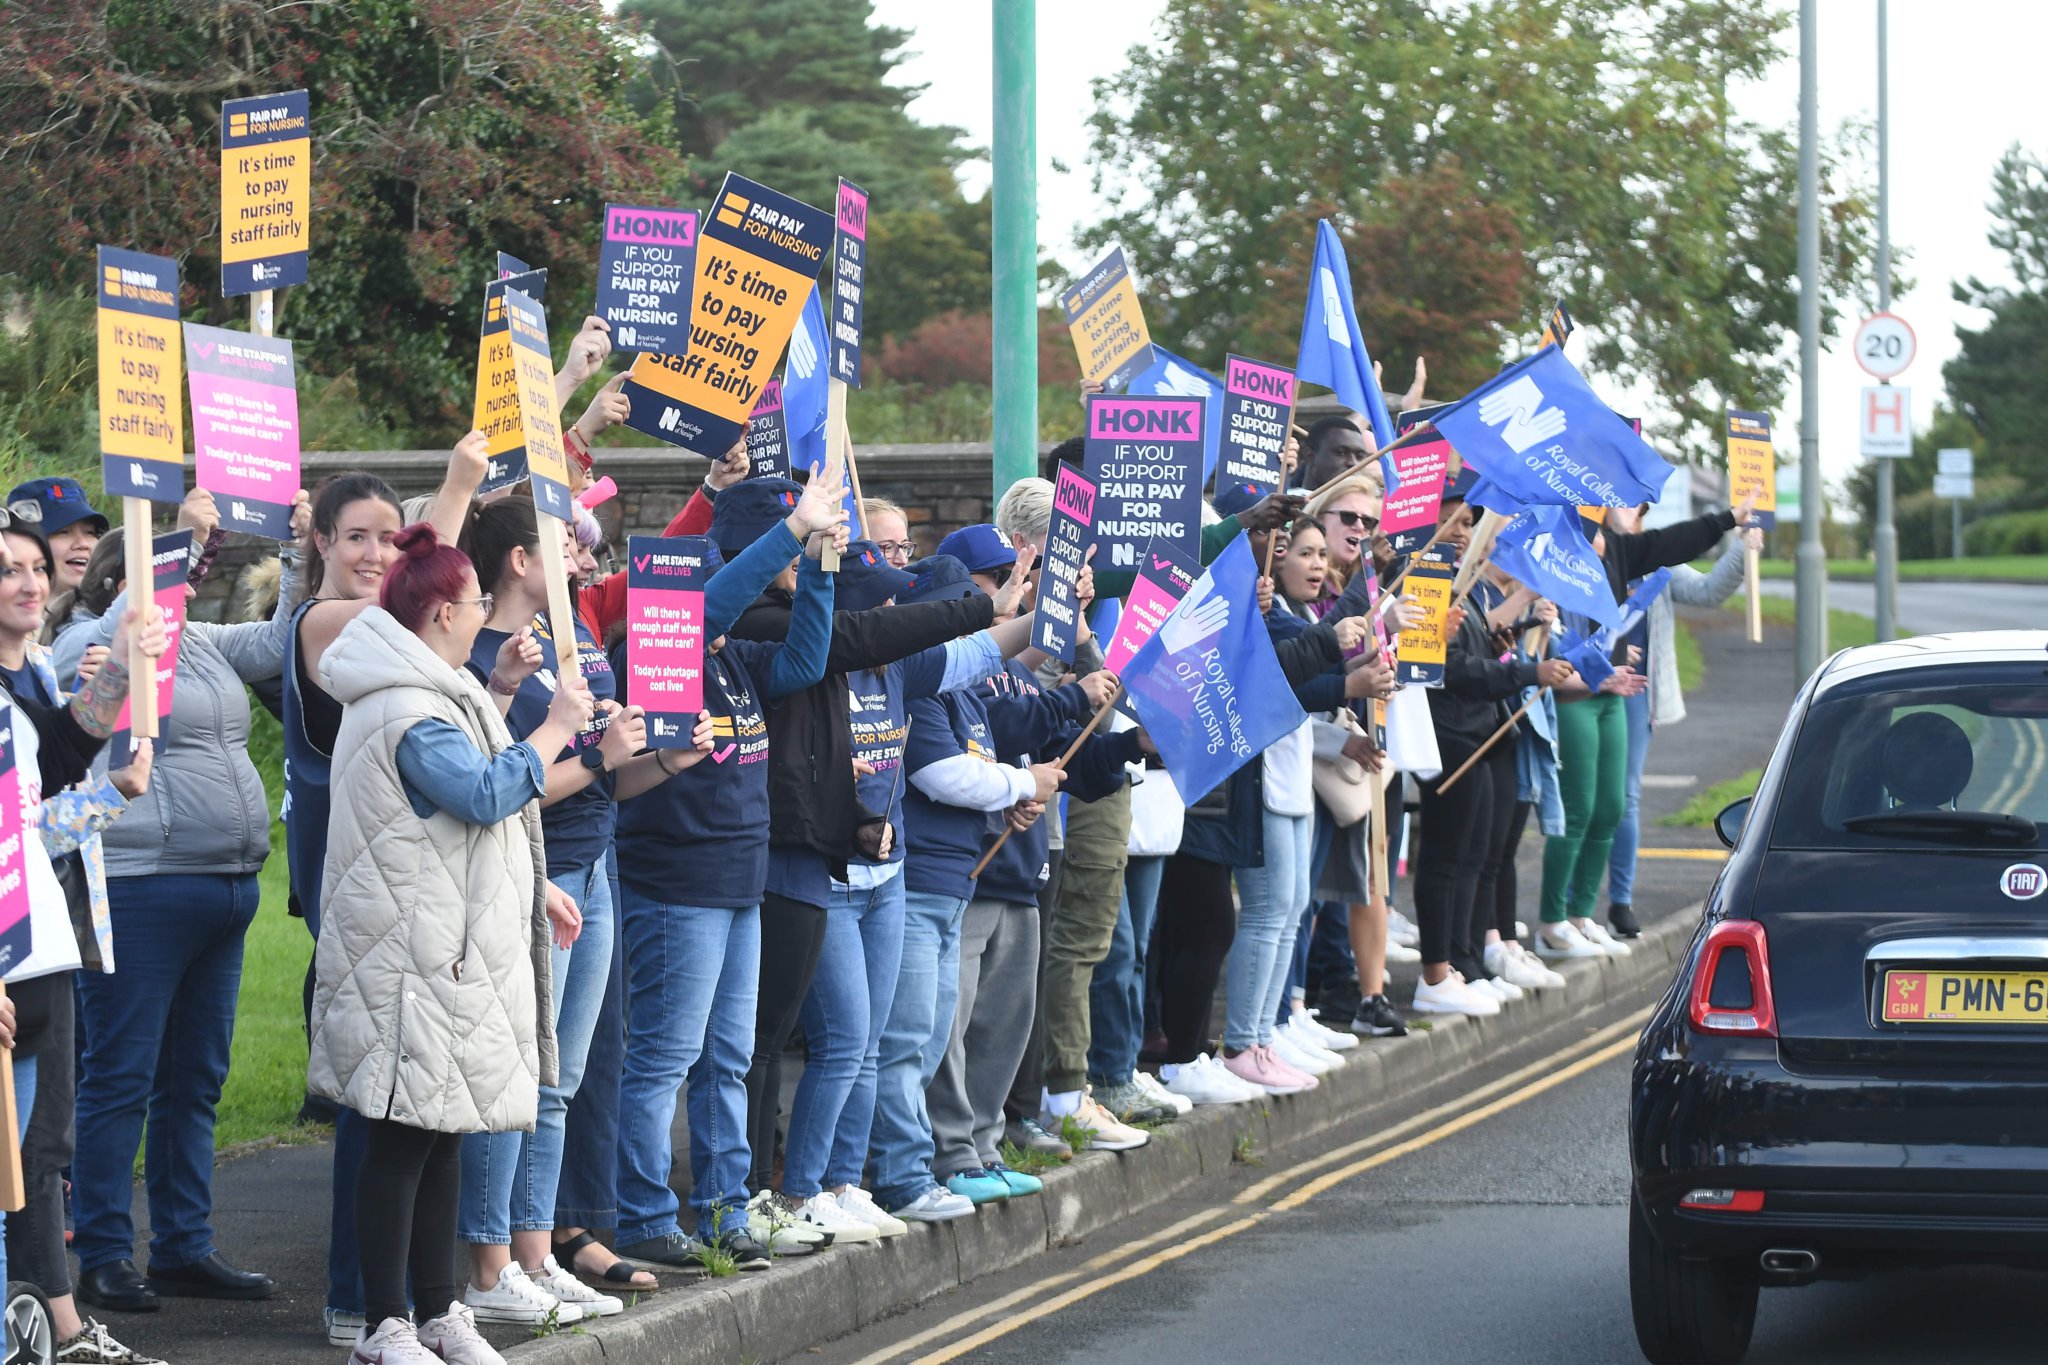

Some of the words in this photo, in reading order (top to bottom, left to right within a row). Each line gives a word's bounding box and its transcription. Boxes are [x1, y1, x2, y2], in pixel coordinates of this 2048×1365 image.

[250, 110, 270, 122] FAIR
[271, 107, 288, 119] PAY
[250, 121, 267, 134] FOR
[268, 116, 304, 131] NURSING
[239, 157, 260, 173] It's
[264, 153, 295, 170] time
[246, 181, 260, 195] to
[264, 178, 288, 197] pay
[240, 198, 293, 219] nursing
[840, 194, 864, 232] HONK
[613, 215, 689, 240] HONK
[749, 202, 778, 227] FAIR
[777, 213, 805, 236] PAY
[231, 224, 264, 244] staff
[267, 219, 301, 239] fairly
[743, 219, 769, 241] FOR
[770, 229, 822, 261] NURSING
[625, 245, 638, 259] IF
[641, 246, 672, 262] YOU
[849, 242, 860, 261] YOU
[612, 260, 682, 279] SUPPORT
[839, 257, 861, 283] SUPPORT
[612, 276, 647, 292] FAIR
[650, 279, 680, 294] PAY
[704, 256, 738, 287] It's
[740, 271, 788, 306] time
[628, 293, 660, 308] FOR
[1099, 292, 1123, 317] time
[607, 307, 678, 325] NURSING
[701, 291, 724, 316] to
[724, 304, 766, 337] pay
[843, 302, 855, 323] FOR
[835, 320, 859, 347] NURSING
[1091, 328, 1102, 341] to
[1103, 310, 1122, 333] pay
[137, 328, 165, 352] time
[1091, 321, 1131, 359] nursing
[1866, 334, 1902, 359] 20
[1089, 351, 1113, 377] staff
[1113, 329, 1140, 356] fairly
[121, 356, 134, 375] to
[138, 362, 159, 384] pay
[491, 371, 502, 386] to
[706, 362, 759, 405] fairly
[1233, 367, 1289, 399] HONK
[117, 387, 165, 414] nursing
[1240, 399, 1252, 413] IF
[1252, 402, 1277, 420] YOU
[1098, 408, 1193, 433] HONK
[1868, 391, 1902, 433] H
[109, 415, 139, 434] staff
[143, 416, 174, 444] fairly
[530, 415, 556, 441] nursing
[757, 416, 774, 429] YOU
[1231, 414, 1284, 437] SUPPORT
[746, 428, 780, 446] SUPPORT
[1230, 429, 1258, 448] FAIR
[1258, 435, 1282, 453] PAY
[530, 440, 547, 458] staff
[766, 443, 782, 457] PAY
[1114, 445, 1130, 460] IF
[1134, 445, 1174, 461] YOU
[1242, 448, 1267, 466] FOR
[758, 459, 775, 473] FOR
[1525, 456, 1551, 471] of
[1545, 444, 1589, 478] Royal
[1099, 463, 1187, 481] SUPPORT
[1226, 461, 1280, 485] NURSING
[1058, 477, 1092, 518] HONK
[1100, 483, 1145, 499] FAIR
[1148, 484, 1186, 500] PAY
[1122, 502, 1162, 518] FOR
[1058, 518, 1067, 535] IF
[1067, 523, 1081, 543] YOU
[1097, 520, 1186, 538] NURSING
[1051, 535, 1082, 565] SUPPORT
[652, 555, 670, 565] SAFE
[670, 555, 701, 567] STAFFING
[652, 565, 673, 575] SAVES
[674, 567, 691, 577] LIVES
[1048, 555, 1065, 579] FAIR
[1063, 564, 1079, 585] PAY
[1171, 565, 1193, 584] SAFE
[1052, 579, 1068, 601] FOR
[1424, 585, 1442, 598] time
[643, 606, 659, 618] Will
[660, 607, 681, 619] there
[681, 609, 691, 619] be
[1041, 595, 1074, 625] NURSING
[1149, 599, 1167, 618] Will
[632, 622, 661, 635] enough
[662, 623, 680, 634] staff
[681, 624, 701, 635] when
[638, 637, 653, 649] you
[654, 636, 673, 648] need
[675, 637, 694, 649] care?
[1401, 637, 1420, 649] staff
[1421, 638, 1440, 653] fairly
[634, 665, 662, 678] Today's
[663, 665, 699, 679] shortages
[1176, 662, 1202, 681] of
[650, 680, 666, 691] cost
[667, 679, 684, 692] lives
[1200, 647, 1236, 699] Royal
[1226, 696, 1252, 757] College
[850, 722, 876, 733] FAIR
[1187, 682, 1225, 755] Nursing
[854, 733, 876, 744] FOR
[857, 749, 883, 761] SAFE
[2010, 873, 2038, 890] FIAT
[1941, 977, 2048, 1012] PMN-6
[1892, 1002, 1919, 1014] GBM
